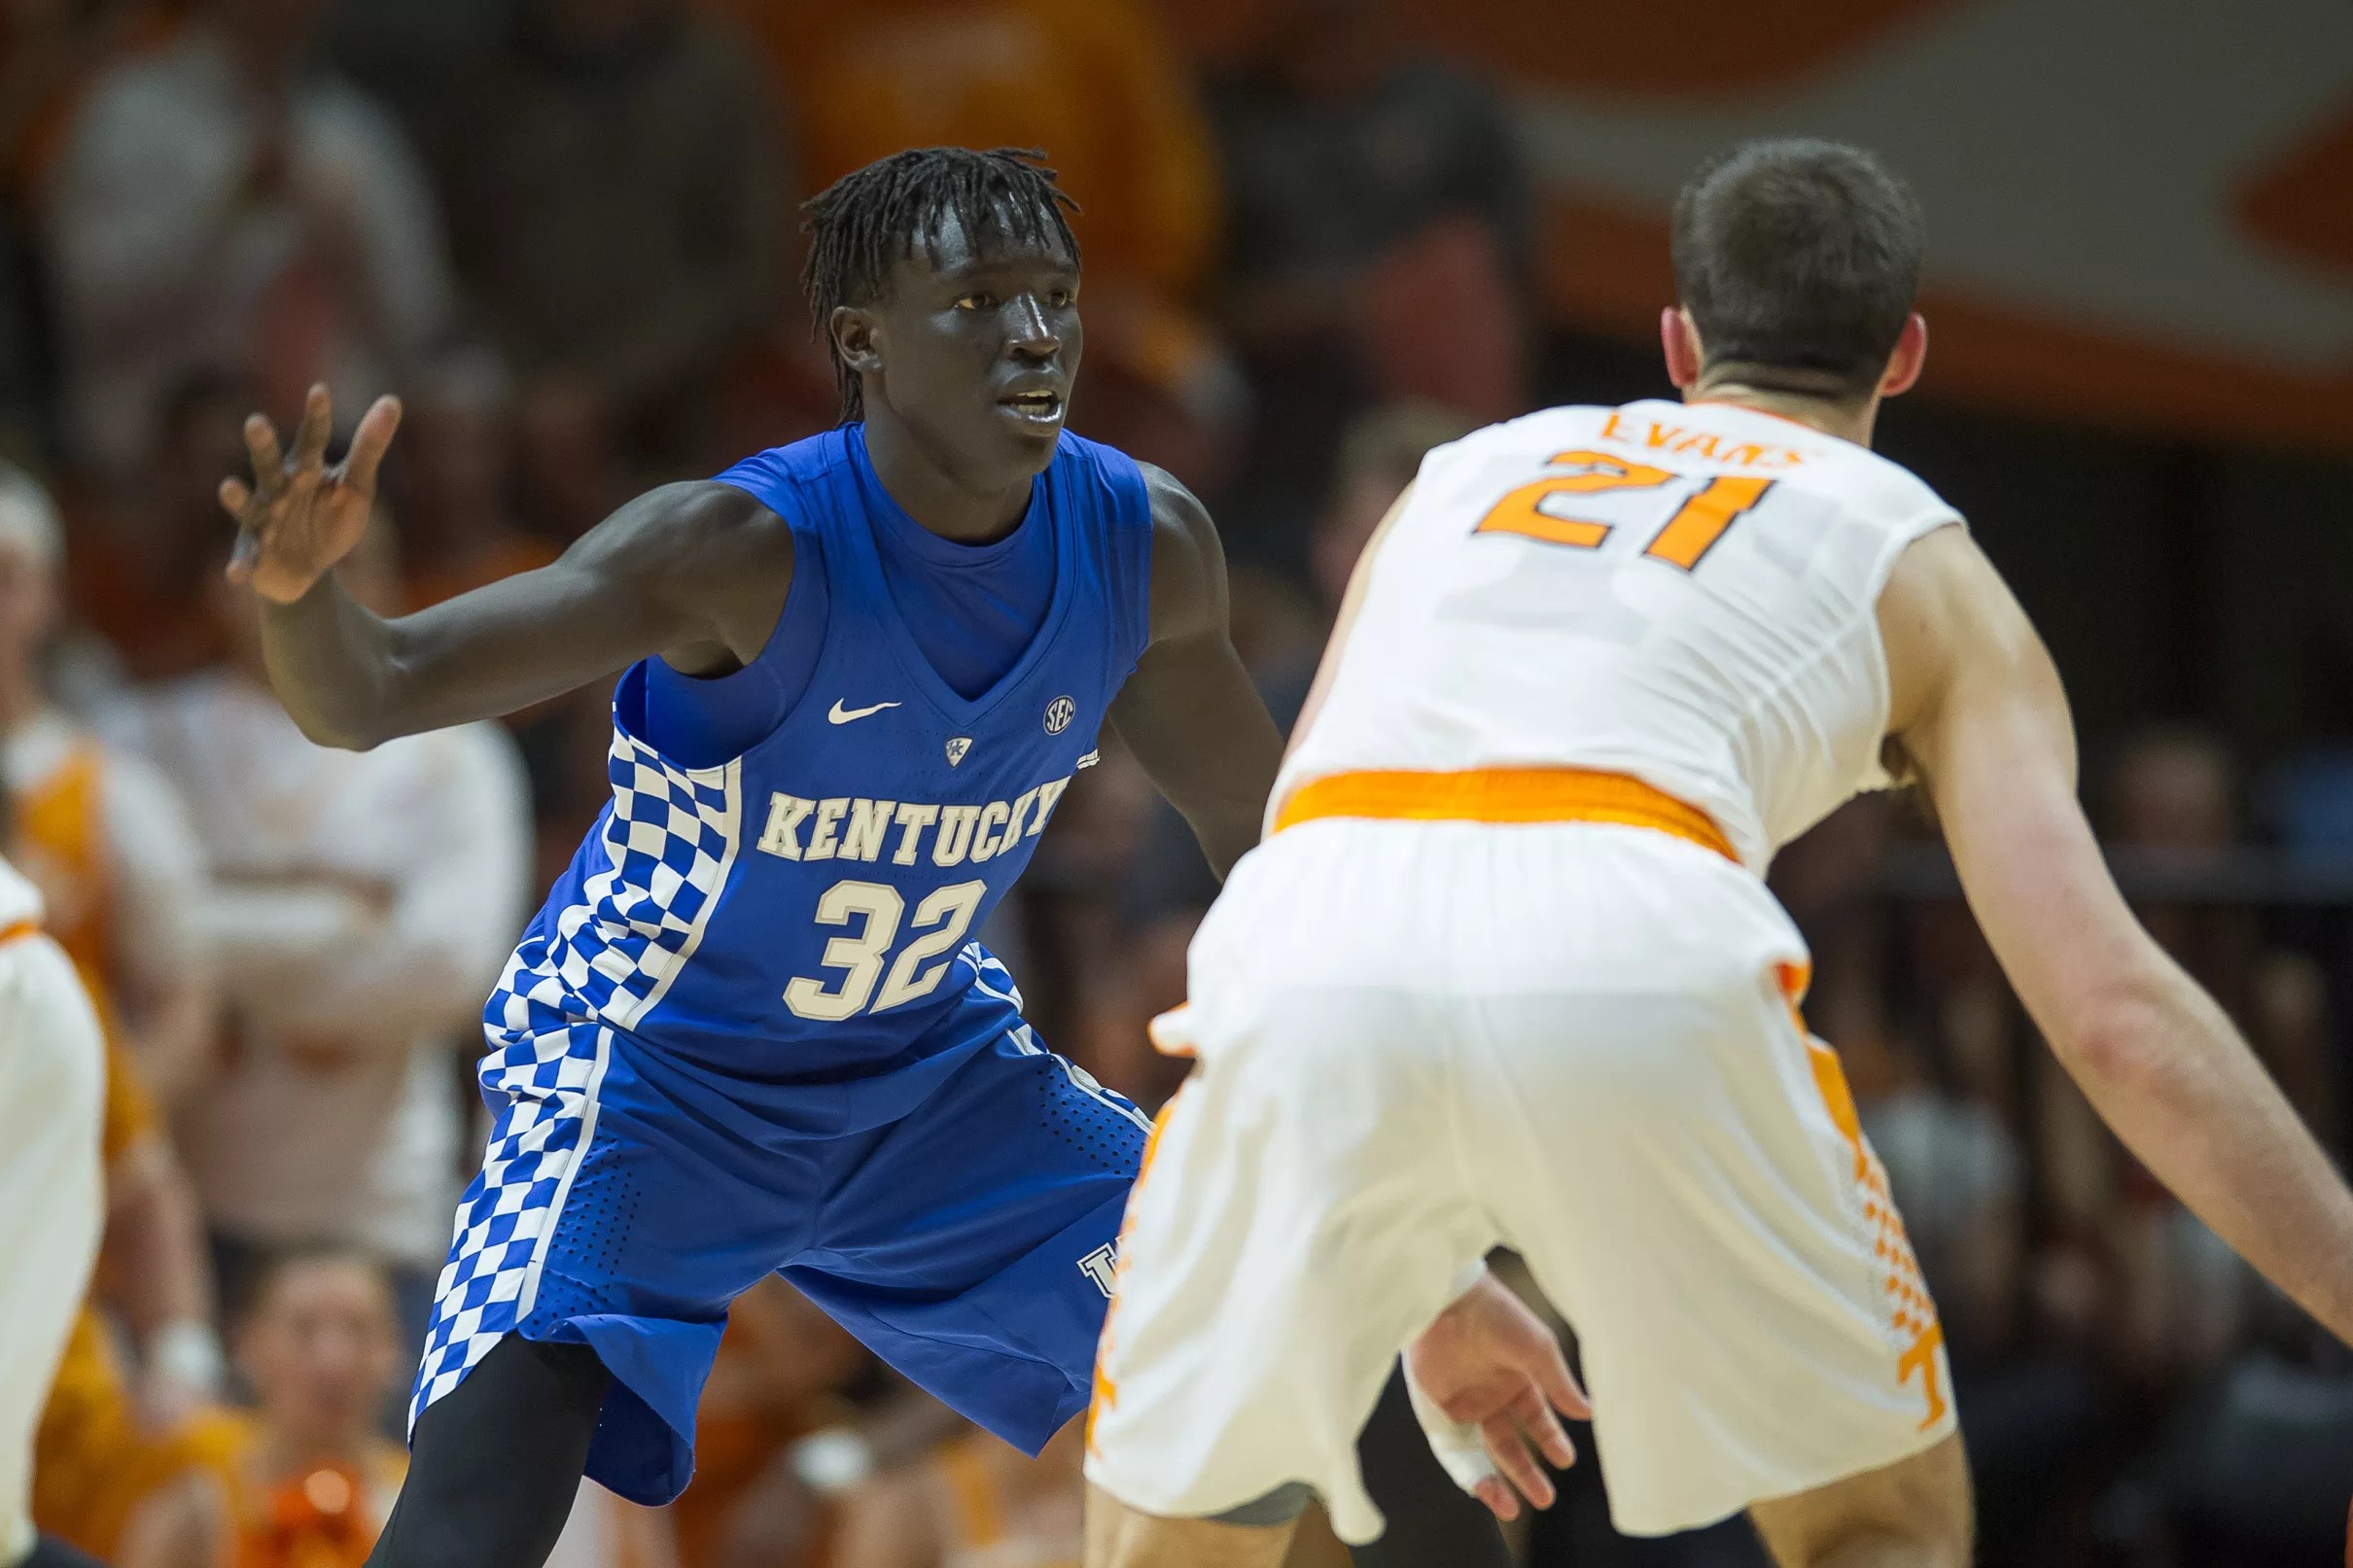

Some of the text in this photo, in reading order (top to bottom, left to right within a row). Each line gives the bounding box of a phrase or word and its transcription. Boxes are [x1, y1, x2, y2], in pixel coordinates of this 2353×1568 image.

[1471, 450, 1776, 571] 21
[1046, 698, 1073, 732] SEC
[755, 775, 1071, 867] KENTUCKY
[782, 879, 988, 1022] 32
